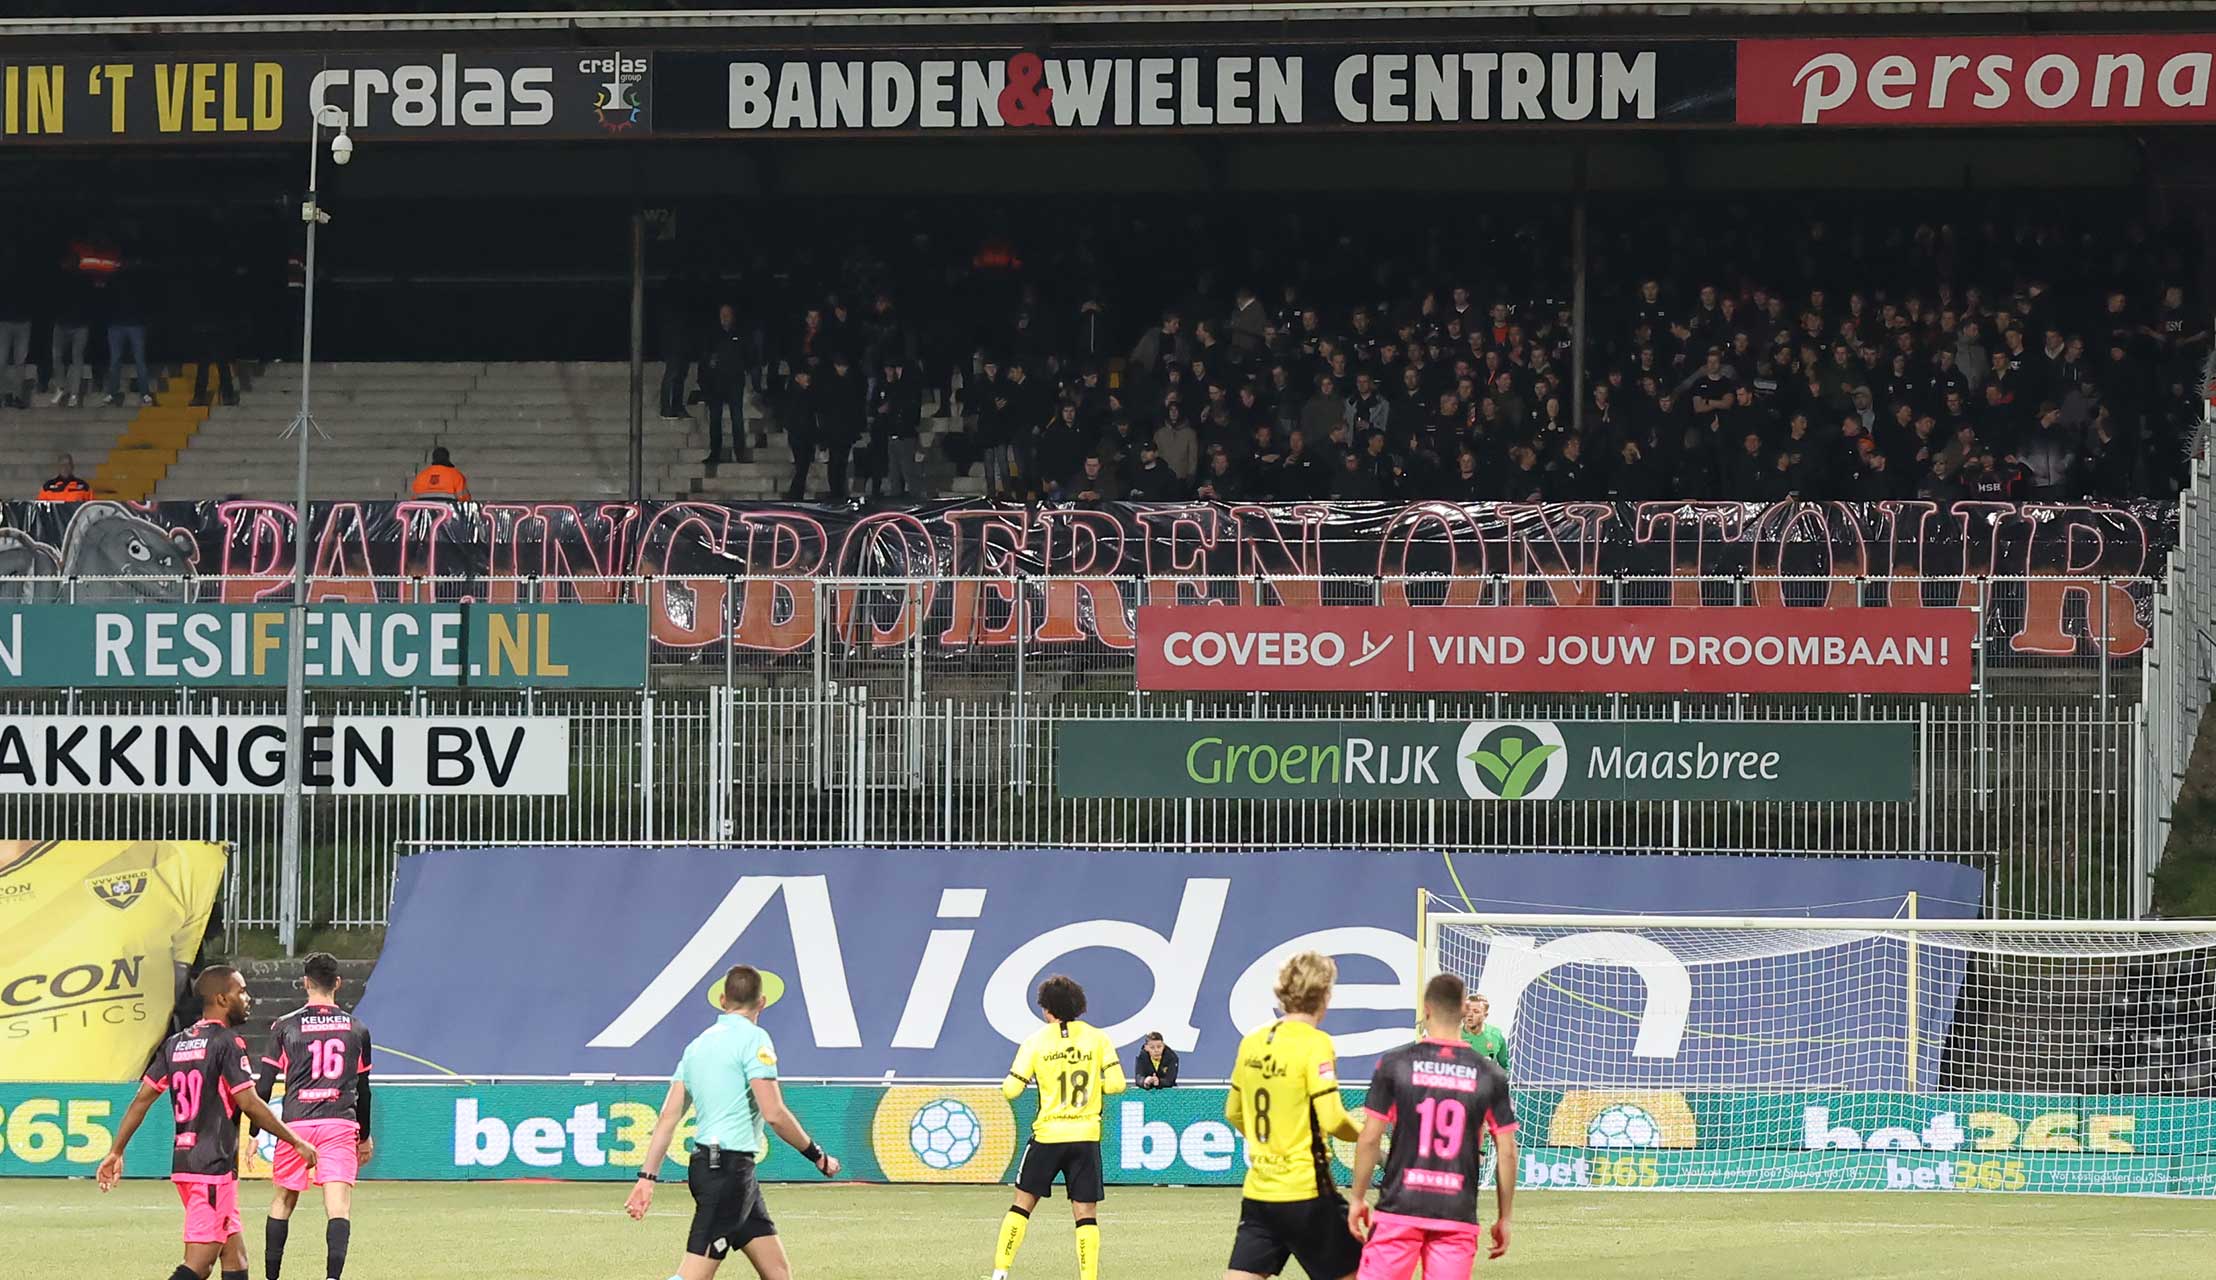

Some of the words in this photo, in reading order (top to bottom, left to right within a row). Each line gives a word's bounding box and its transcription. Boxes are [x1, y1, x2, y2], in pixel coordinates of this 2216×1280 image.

[5, 65, 64, 134] IN
[155, 62, 283, 132] VELD
[309, 54, 555, 128] cr8las
[1334, 52, 1657, 123] CENTRUM
[1792, 53, 2213, 124] persona
[95, 612, 569, 677] RESIFENCE.NL
[1163, 631, 1346, 667] COVEBO
[1428, 635, 1525, 665] VIND
[1538, 636, 1656, 667] JOUW
[1670, 636, 1950, 667] DROOMBAAN!
[427, 726, 525, 787] BV
[1587, 741, 1780, 781] Maasbree
[302, 1016, 350, 1025] KEUKEN
[307, 1038, 346, 1080] 16
[1413, 1060, 1477, 1079] KEUKEN
[171, 1069, 204, 1123] 30
[1057, 1070, 1089, 1107] 18
[1255, 1087, 1271, 1143] 8
[0, 1098, 113, 1163] 65
[1415, 1097, 1466, 1161] 19
[1525, 1154, 1659, 1185] bet365
[1887, 1158, 2026, 1189] bet365
